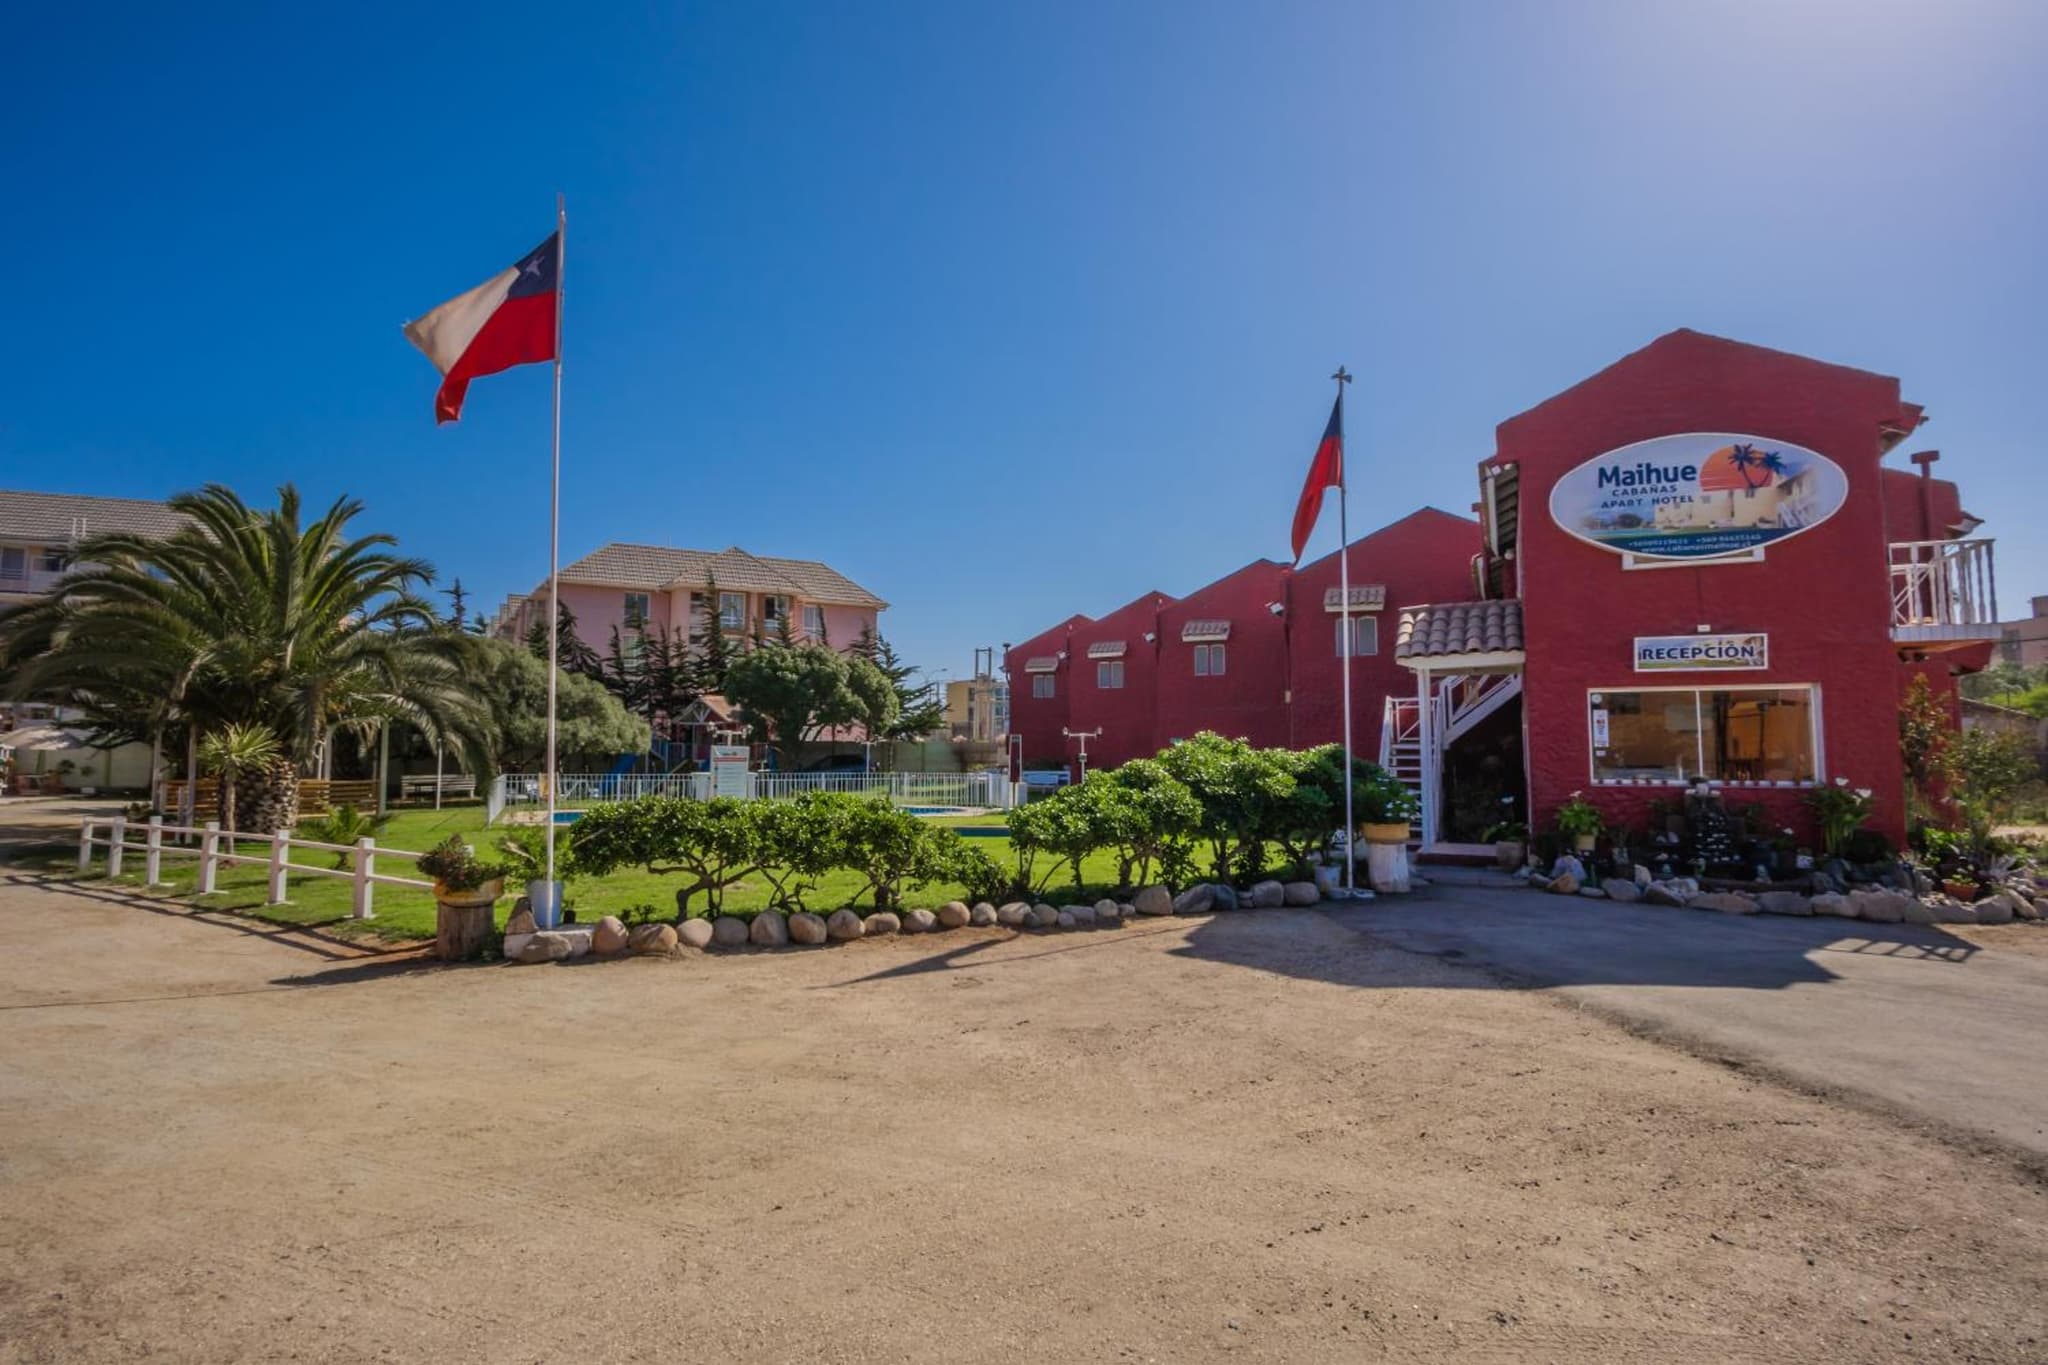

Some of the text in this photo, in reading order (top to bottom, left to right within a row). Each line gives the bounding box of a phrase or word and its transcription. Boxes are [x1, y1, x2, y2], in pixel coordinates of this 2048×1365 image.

[1597, 462, 1697, 488] Maihue
[1612, 484, 1678, 497] CABAÑAS
[1601, 495, 1694, 509] APART HOTEL
[1642, 643, 1755, 660] RECEPCIÓN
